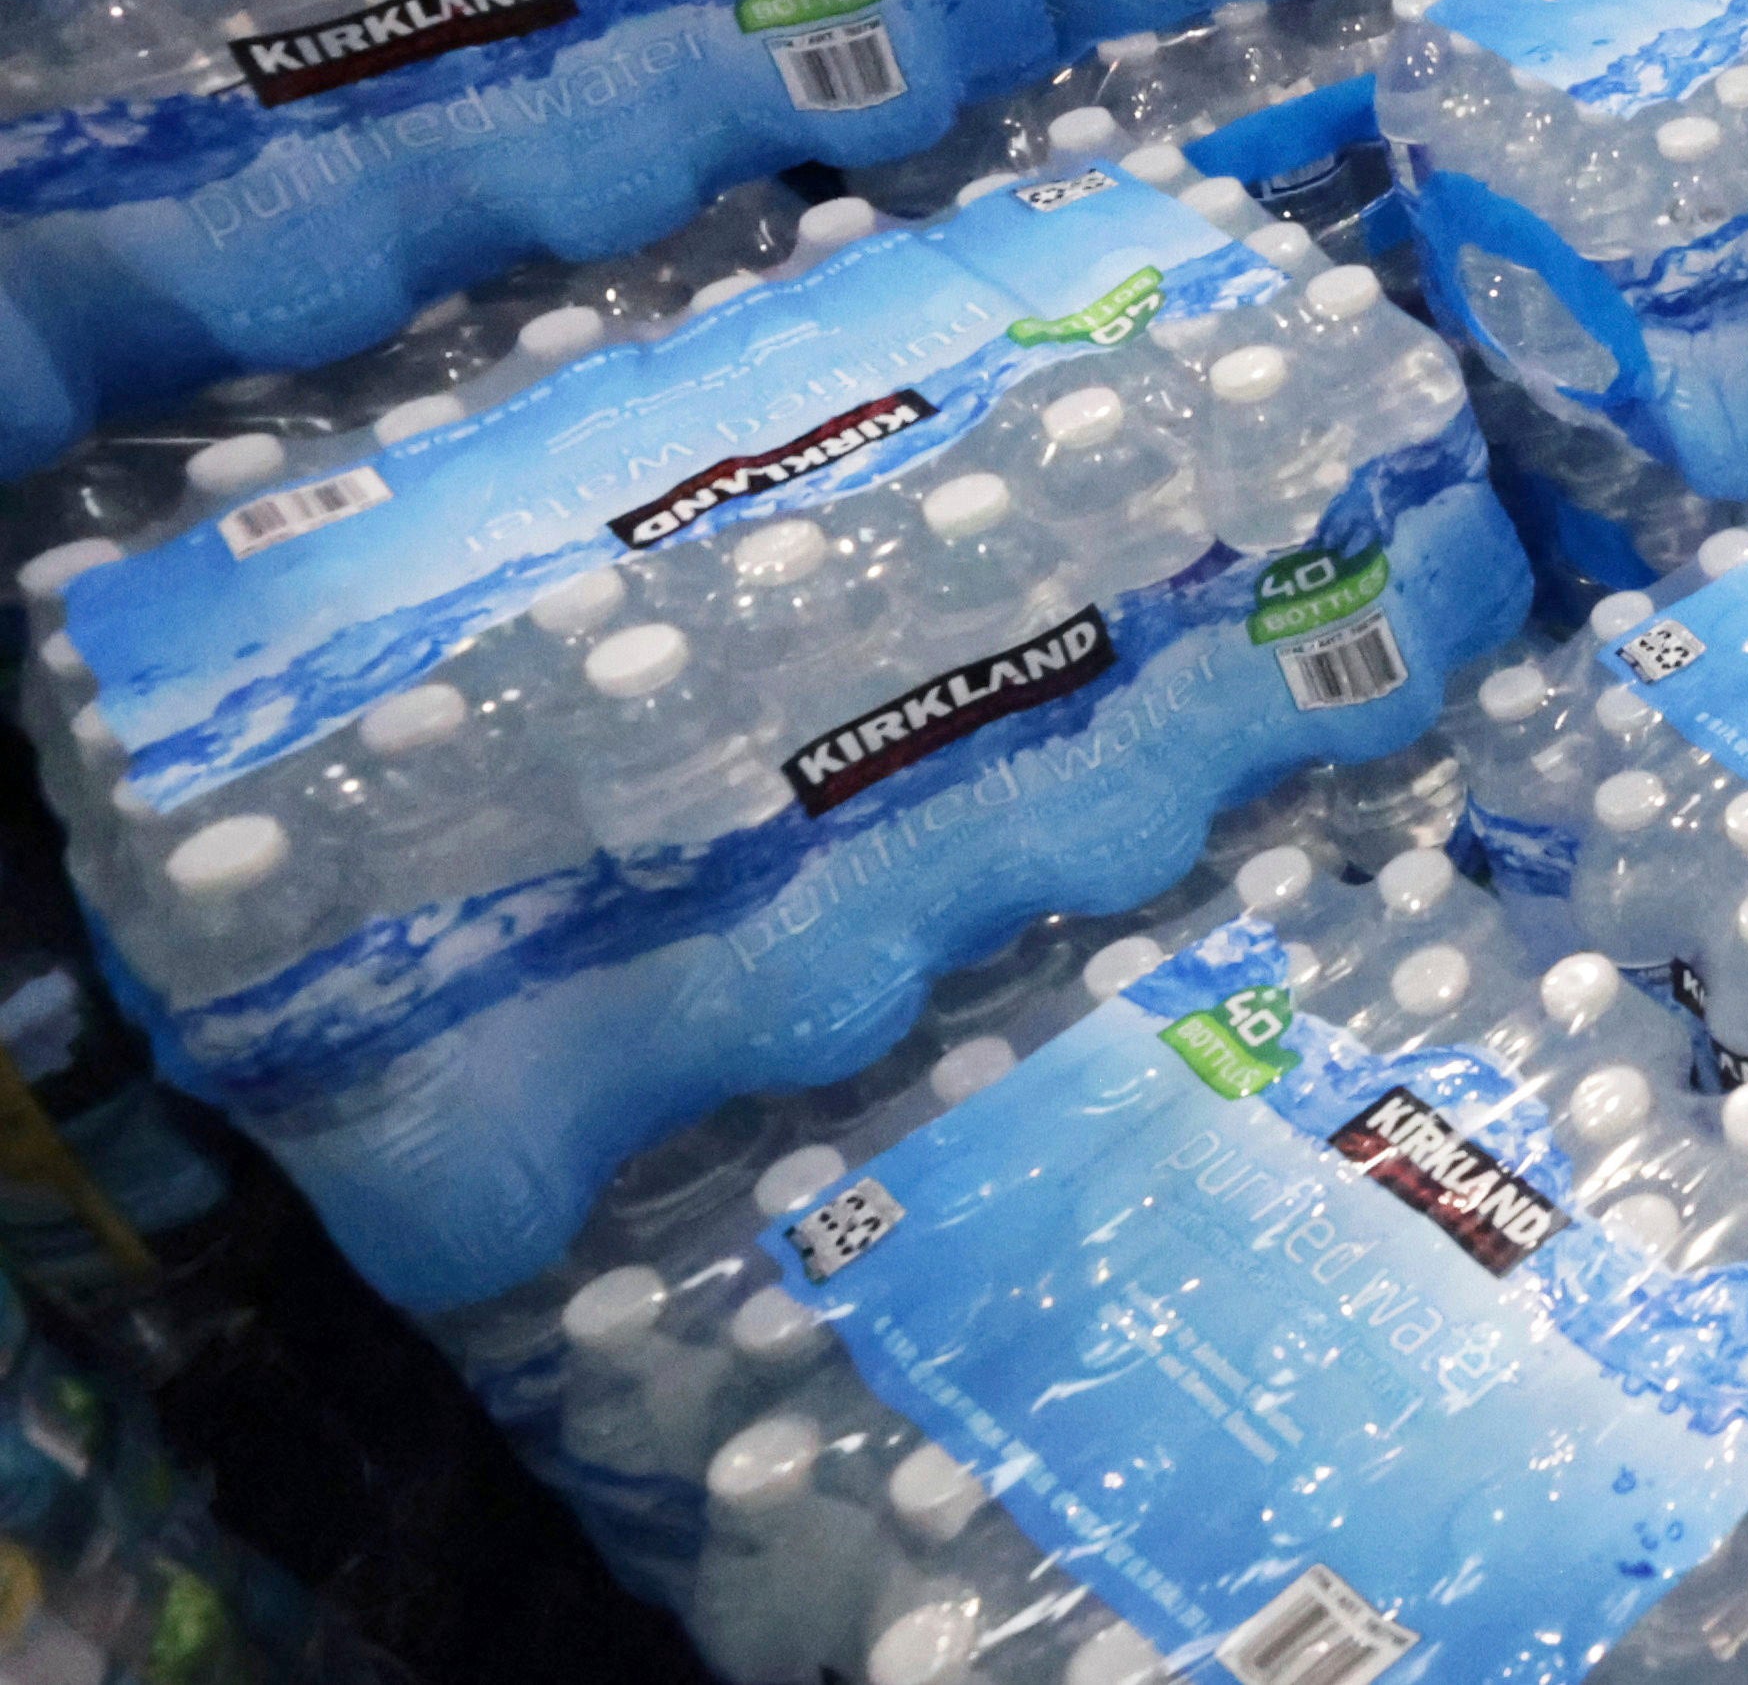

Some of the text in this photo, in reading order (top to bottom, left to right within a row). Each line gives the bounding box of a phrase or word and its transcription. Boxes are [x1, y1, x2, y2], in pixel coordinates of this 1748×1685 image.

[198, 28, 709, 250] purified water
[723, 302, 992, 451] purified
[1095, 293, 1162, 344] 40
[630, 403, 914, 545] KIRKLAND
[1259, 556, 1338, 603] 40
[1264, 566, 1386, 637] BOTTLES
[798, 619, 1098, 787] KIRKLAND
[727, 647, 1227, 974] purified water
[1171, 1015, 1264, 1095] BOTTLES
[1218, 987, 1275, 1046] 40
[1365, 1094, 1557, 1252] KIRKLAND
[1155, 1120, 1379, 1286] purified
[1347, 1251, 1520, 1417] water
